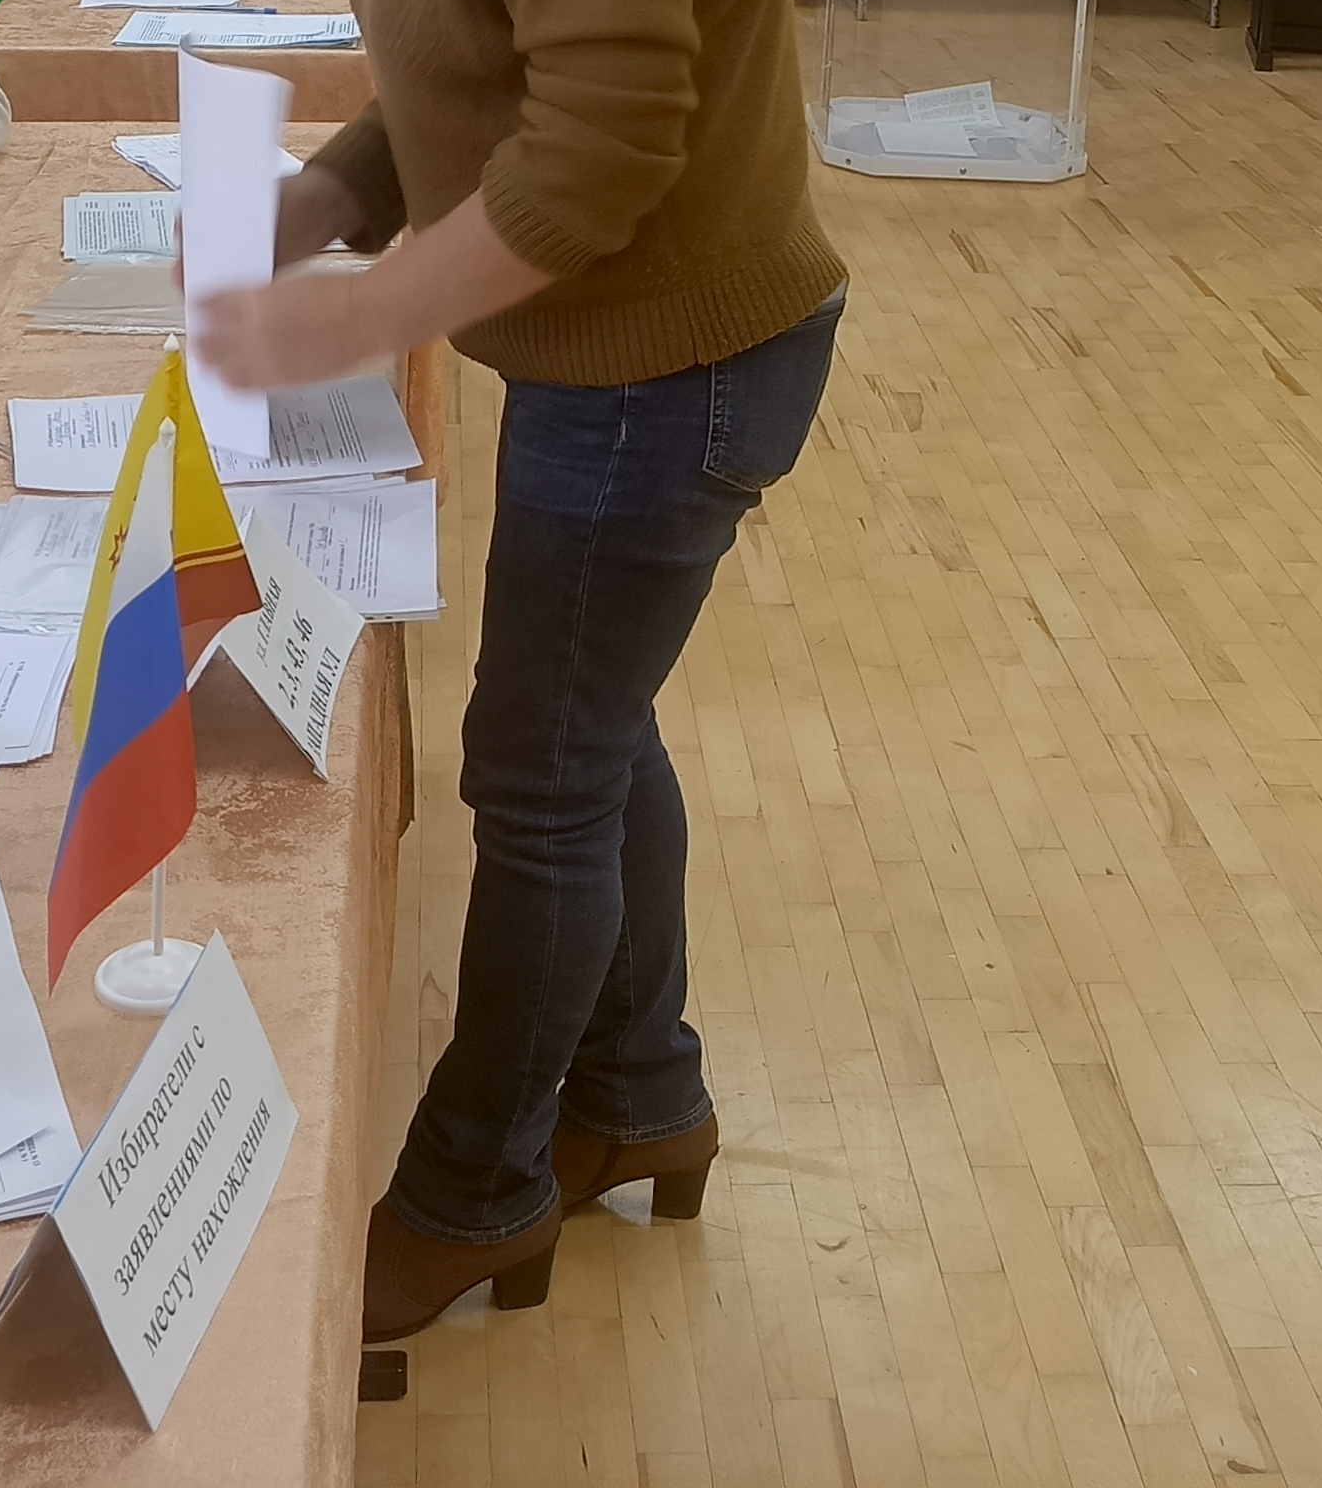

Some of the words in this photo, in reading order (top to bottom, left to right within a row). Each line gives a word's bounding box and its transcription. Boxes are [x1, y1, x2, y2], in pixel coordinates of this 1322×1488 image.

[292, 608, 314, 643] 46
[320, 645, 341, 677] УЛ
[95, 1047, 197, 1209] Избиратели
[190, 1023, 207, 1052] с
[112, 1112, 217, 1298] заявлениями
[211, 1075, 234, 1121] по
[141, 1255, 196, 1359] месту
[190, 1096, 272, 1266] нахождения
